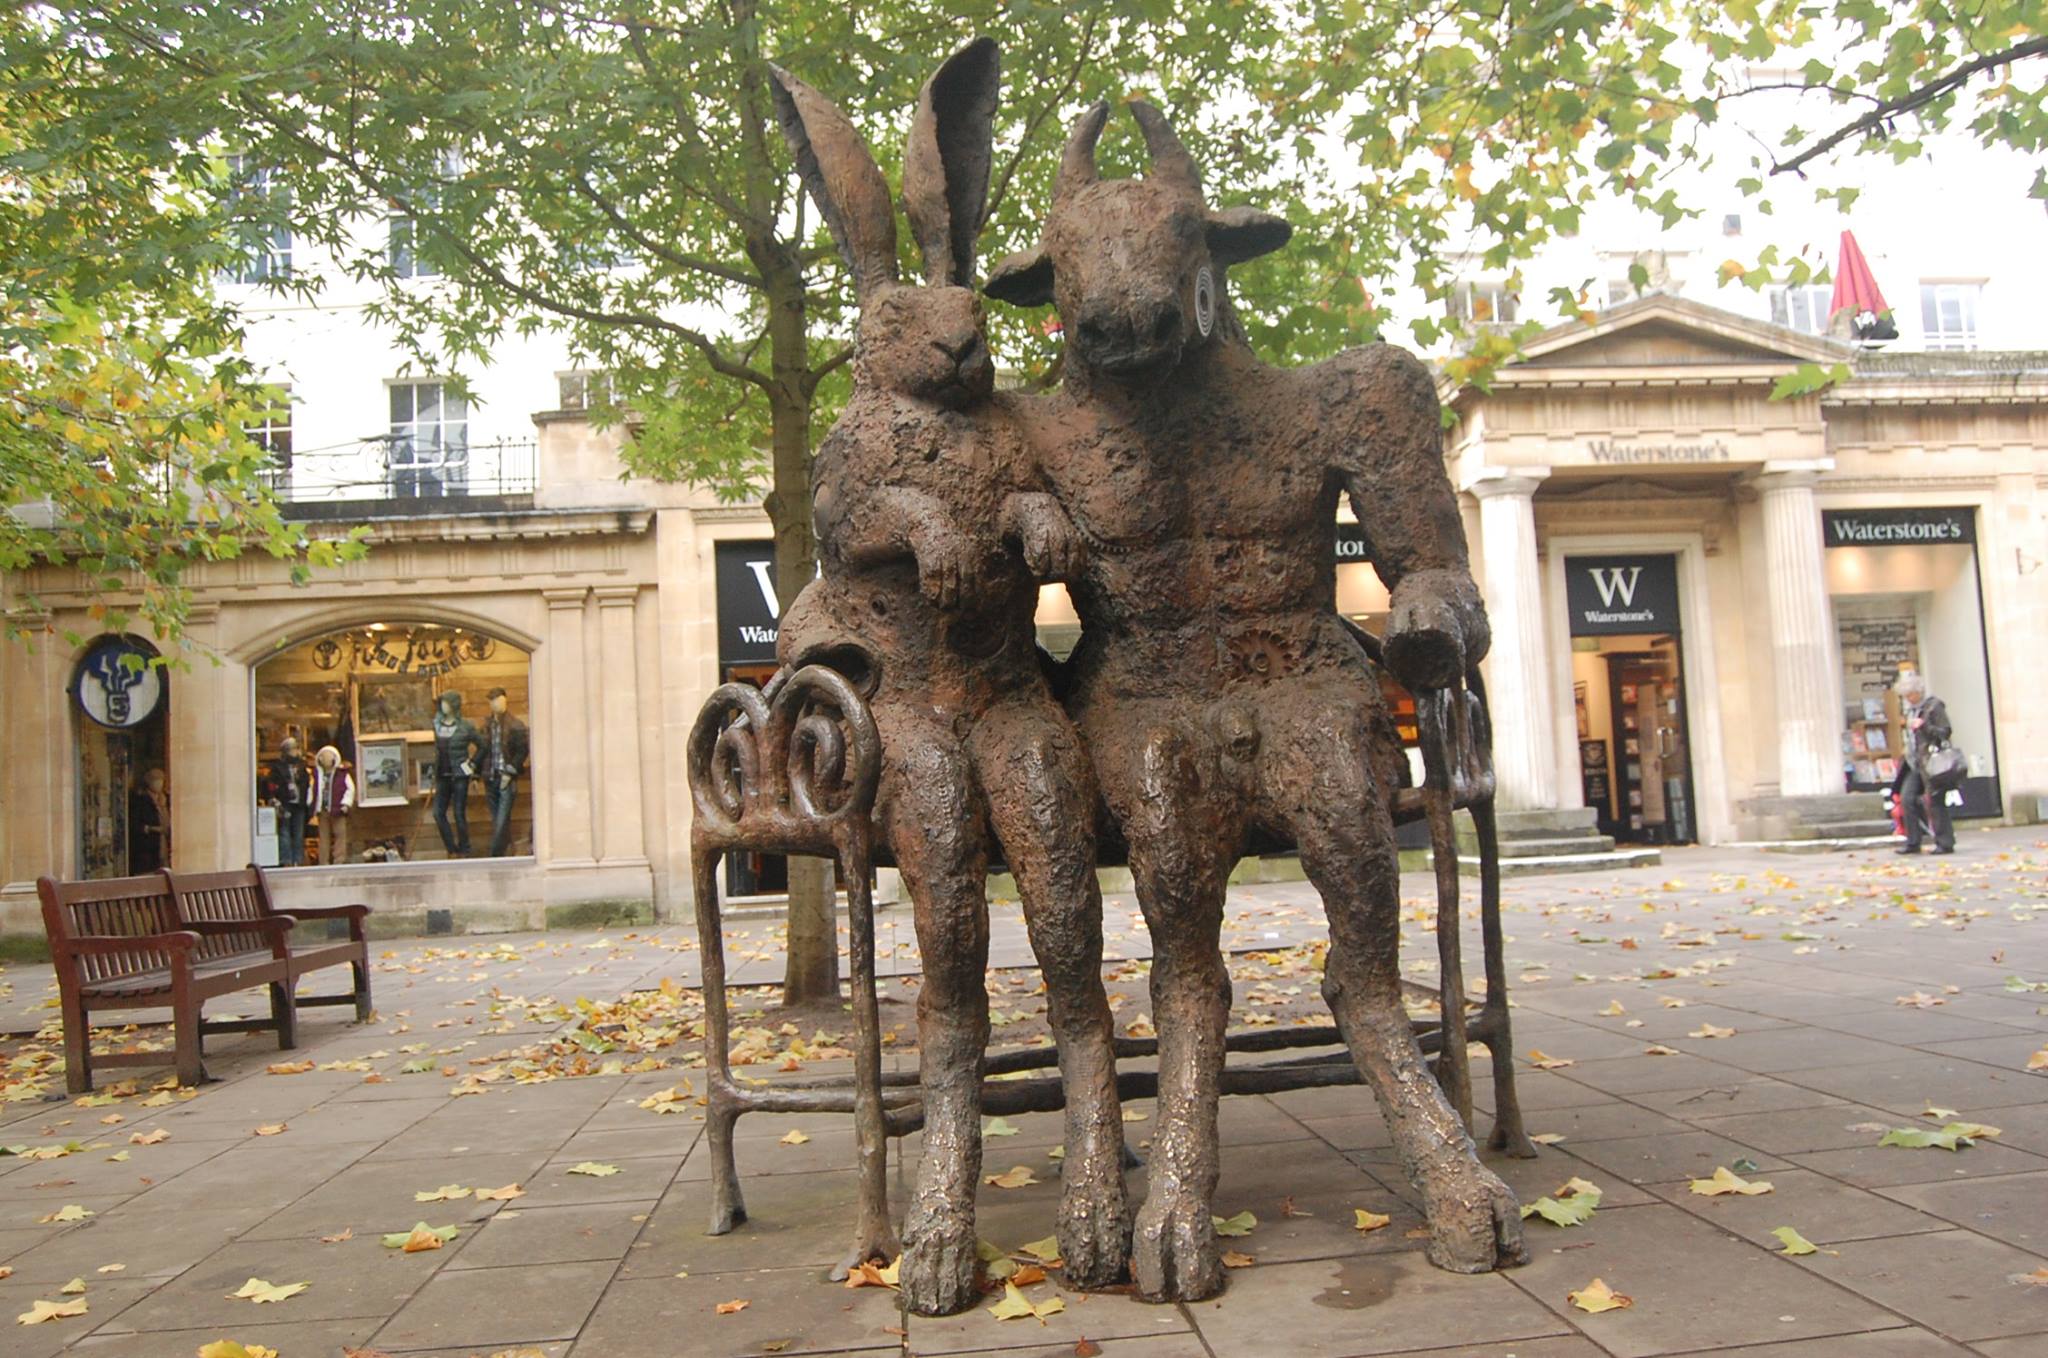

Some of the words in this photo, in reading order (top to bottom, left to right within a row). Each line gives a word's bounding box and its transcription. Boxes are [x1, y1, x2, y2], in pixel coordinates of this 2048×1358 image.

[1587, 439, 1729, 463] Waterstone's
[1833, 517, 1961, 540] Waterstone's
[1588, 566, 1644, 608] W
[1584, 609, 1655, 622] Waterstone's
